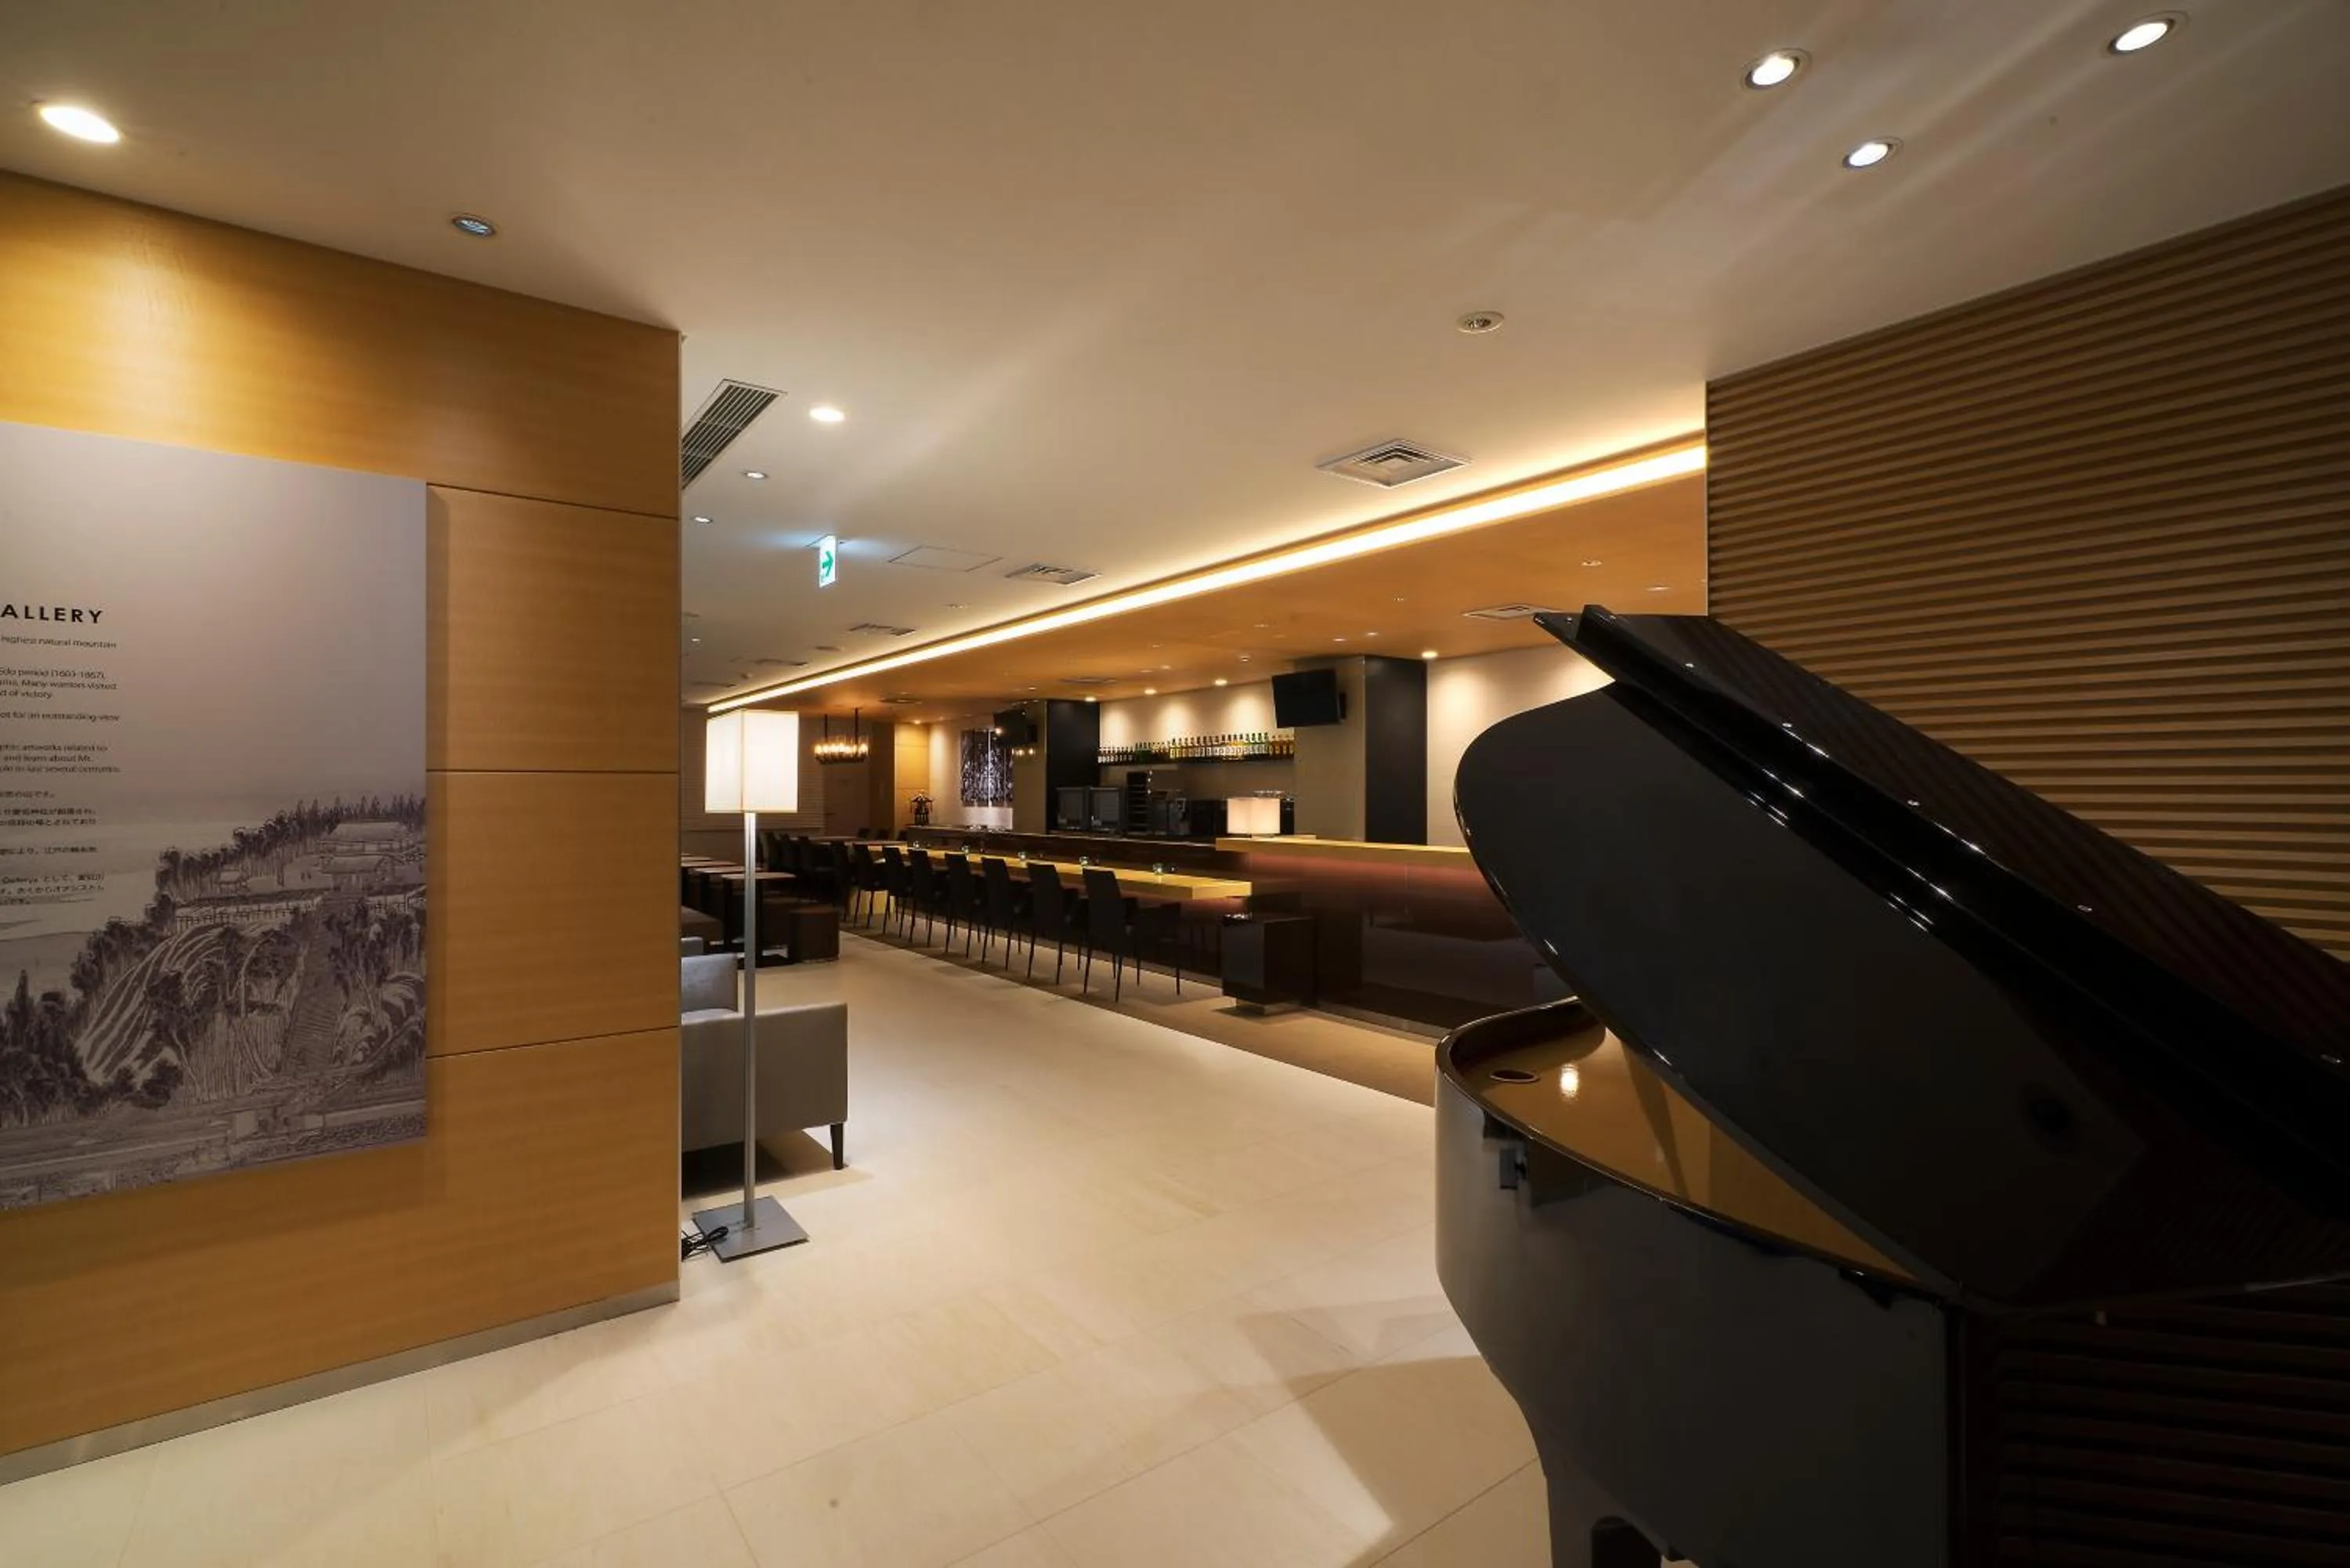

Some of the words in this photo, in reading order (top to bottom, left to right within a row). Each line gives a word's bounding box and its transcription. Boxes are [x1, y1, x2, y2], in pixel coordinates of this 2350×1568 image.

[0, 604, 103, 624] ALLERY
[1, 634, 37, 645] highest
[38, 638, 71, 647] natural
[73, 639, 118, 649] mountain
[18, 669, 49, 678] period
[21, 679, 48, 688] Many
[49, 681, 85, 689] warriors
[87, 681, 118, 690] visited
[9, 688, 19, 697] of
[42, 712, 97, 723] outstanding
[98, 714, 120, 722] view
[23, 743, 62, 752] artworks
[3, 753, 21, 762] and
[49, 753, 76, 763] about
